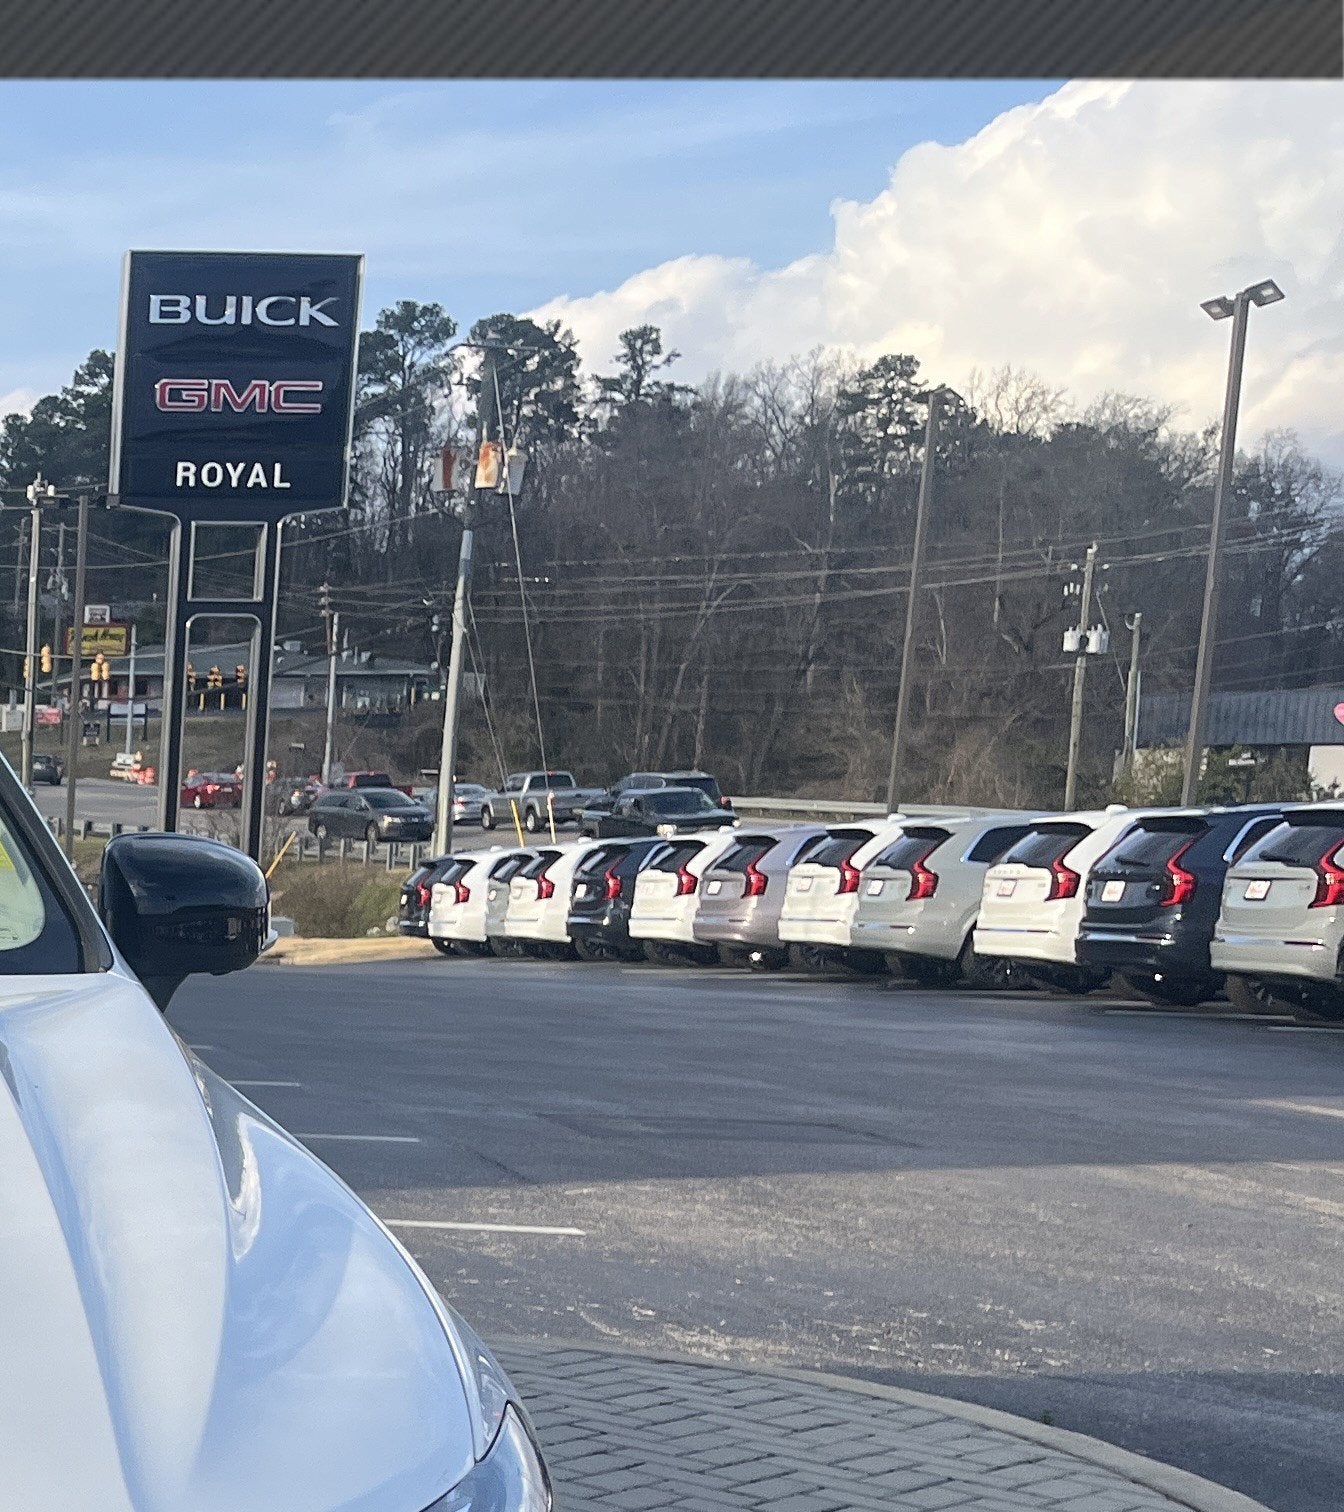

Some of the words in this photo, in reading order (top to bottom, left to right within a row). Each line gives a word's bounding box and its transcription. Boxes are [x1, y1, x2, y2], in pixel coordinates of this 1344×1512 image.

[148, 294, 339, 327] BUICK
[156, 378, 324, 414] GMC
[175, 461, 291, 489] ROYAL
